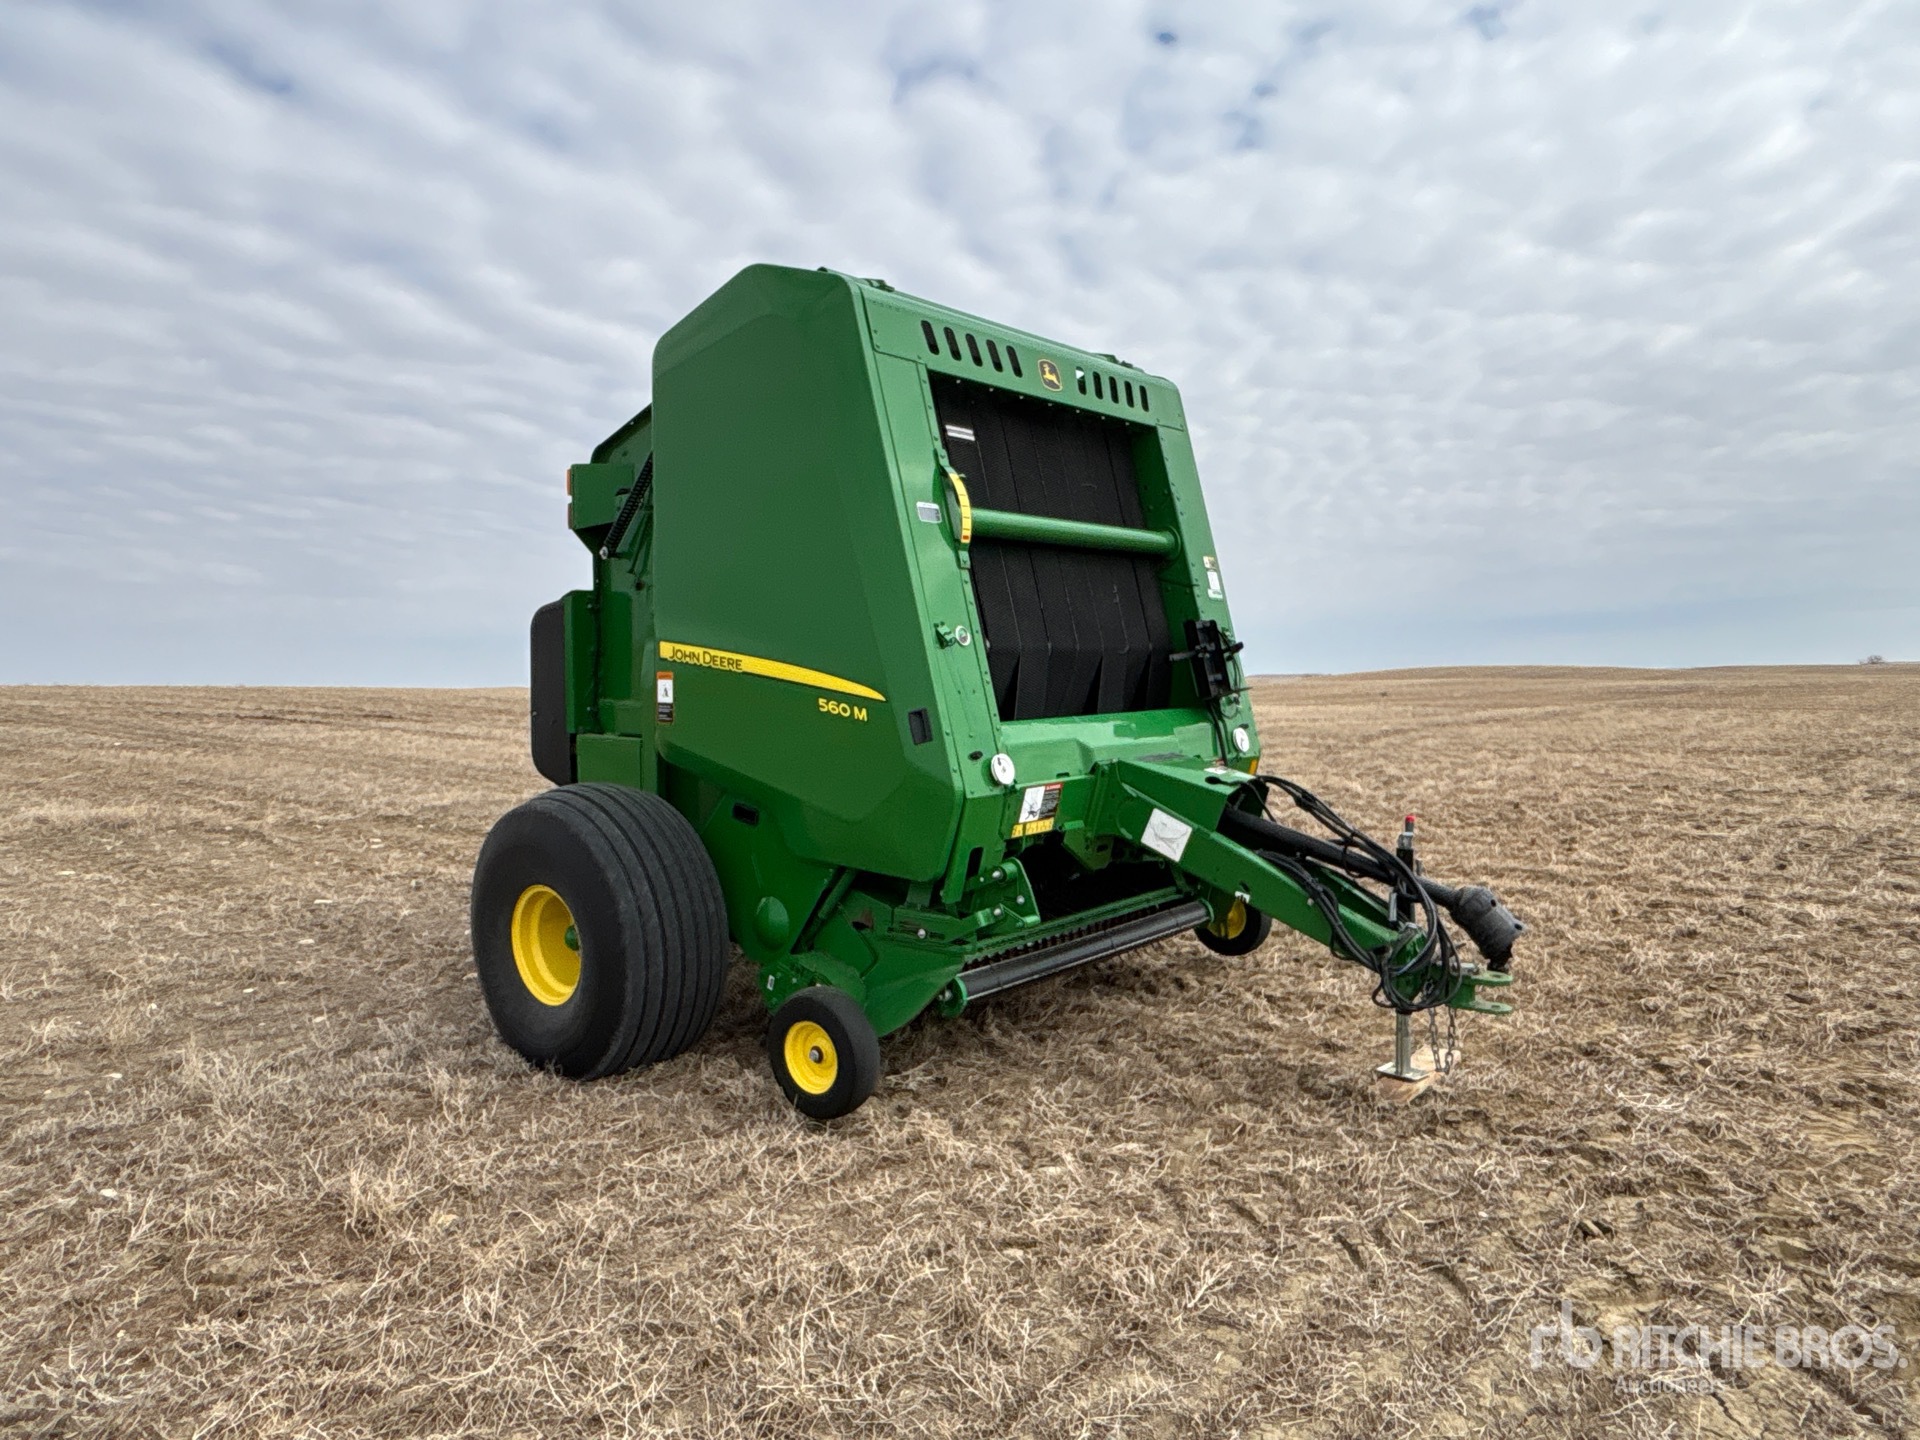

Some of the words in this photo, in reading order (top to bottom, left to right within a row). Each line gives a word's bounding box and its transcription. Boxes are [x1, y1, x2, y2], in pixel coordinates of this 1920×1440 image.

[669, 646, 700, 663] JOHN
[702, 651, 743, 670] DEERE
[818, 698, 851, 718] 560
[853, 707, 868, 722] M
